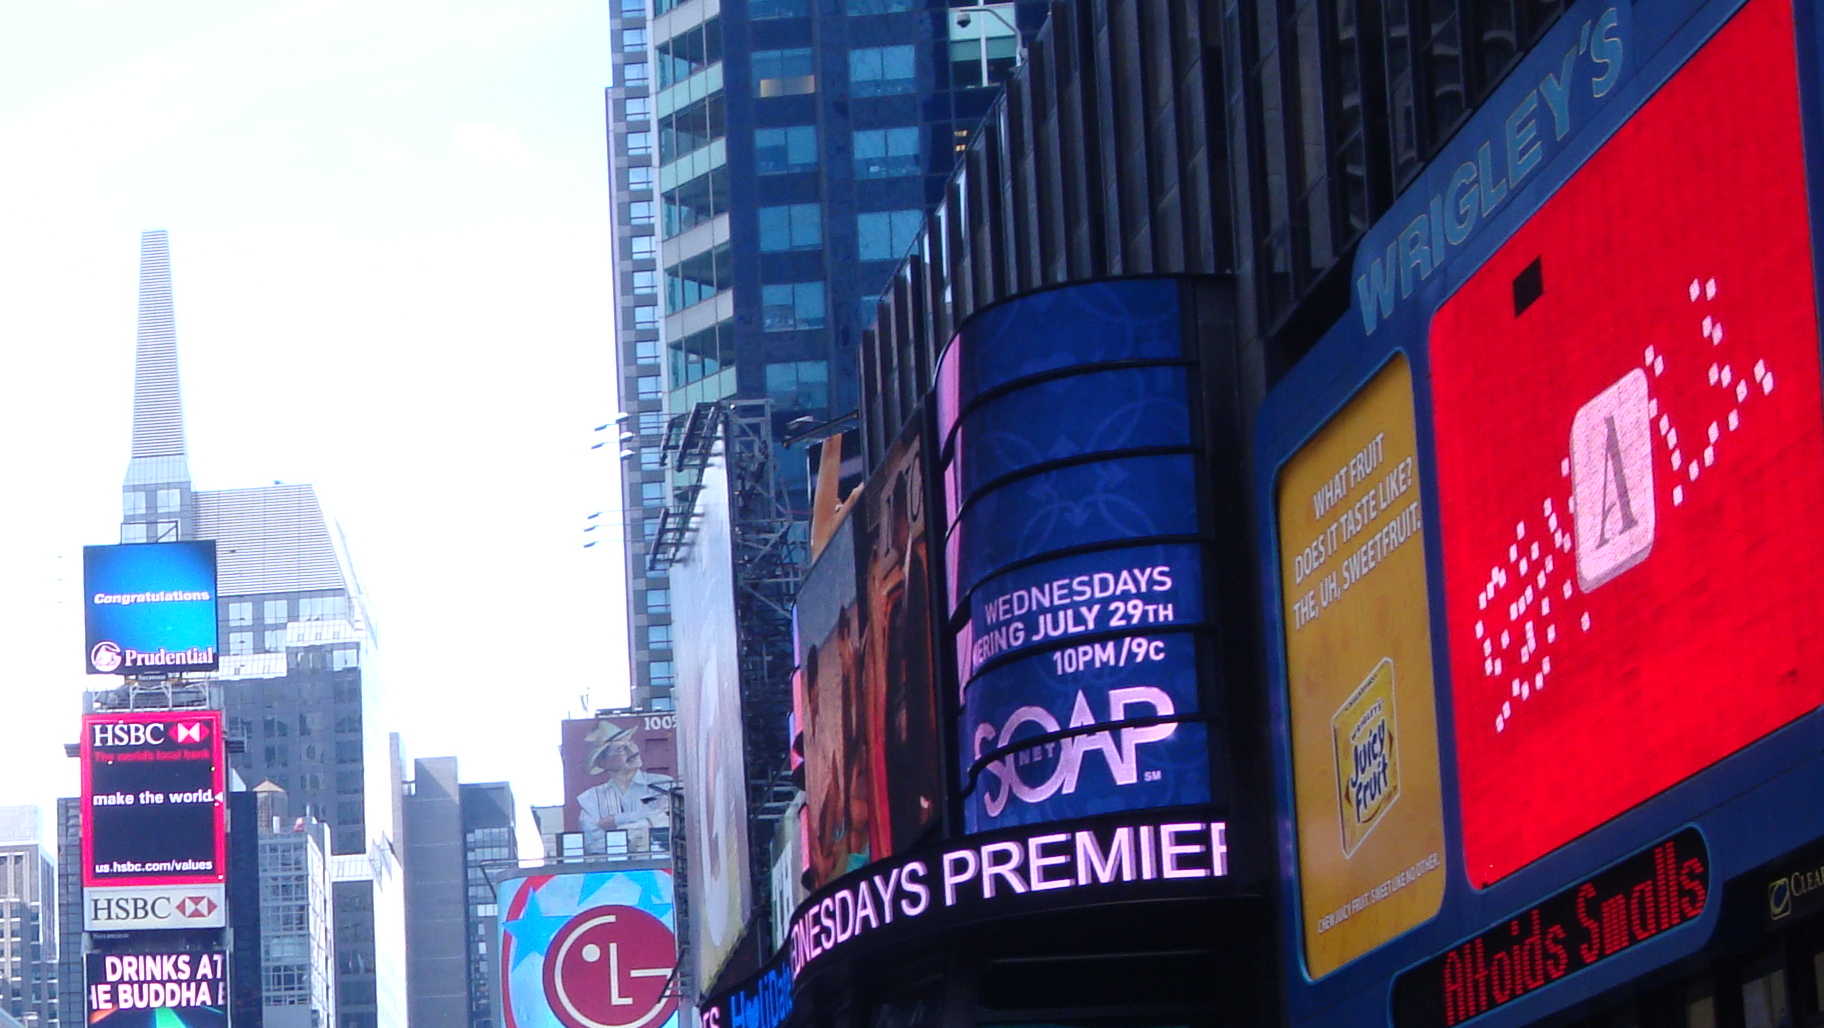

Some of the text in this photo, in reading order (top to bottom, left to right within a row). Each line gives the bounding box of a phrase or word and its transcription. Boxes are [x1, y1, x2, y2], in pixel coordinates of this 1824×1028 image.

[1356, 7, 1624, 337] WRIGLEY'S
[1313, 432, 1384, 520] WHAT FRUIT
[1295, 456, 1412, 584] DOES IT TASTE LIKE?
[93, 591, 211, 605] Congratulations
[984, 566, 1172, 626] WEDNESDAYS
[1293, 590, 1319, 630] THE,
[1320, 572, 1341, 608] UH,
[125, 647, 214, 667] Prudential
[974, 599, 1173, 665] ERING JULY 29TH
[94, 723, 165, 746] HSBC
[975, 686, 1178, 817] SOAP
[1350, 719, 1386, 784] Juicy
[93, 792, 134, 805] make
[139, 791, 163, 804] the
[1356, 754, 1388, 824] Fruit
[95, 860, 213, 873] us.hsbc.com/values
[91, 897, 171, 921] HSBC
[1444, 841, 1707, 1026] Altoids Smalls
[105, 954, 223, 981] DRINKS AT
[118, 982, 211, 1009] BUDDHA
